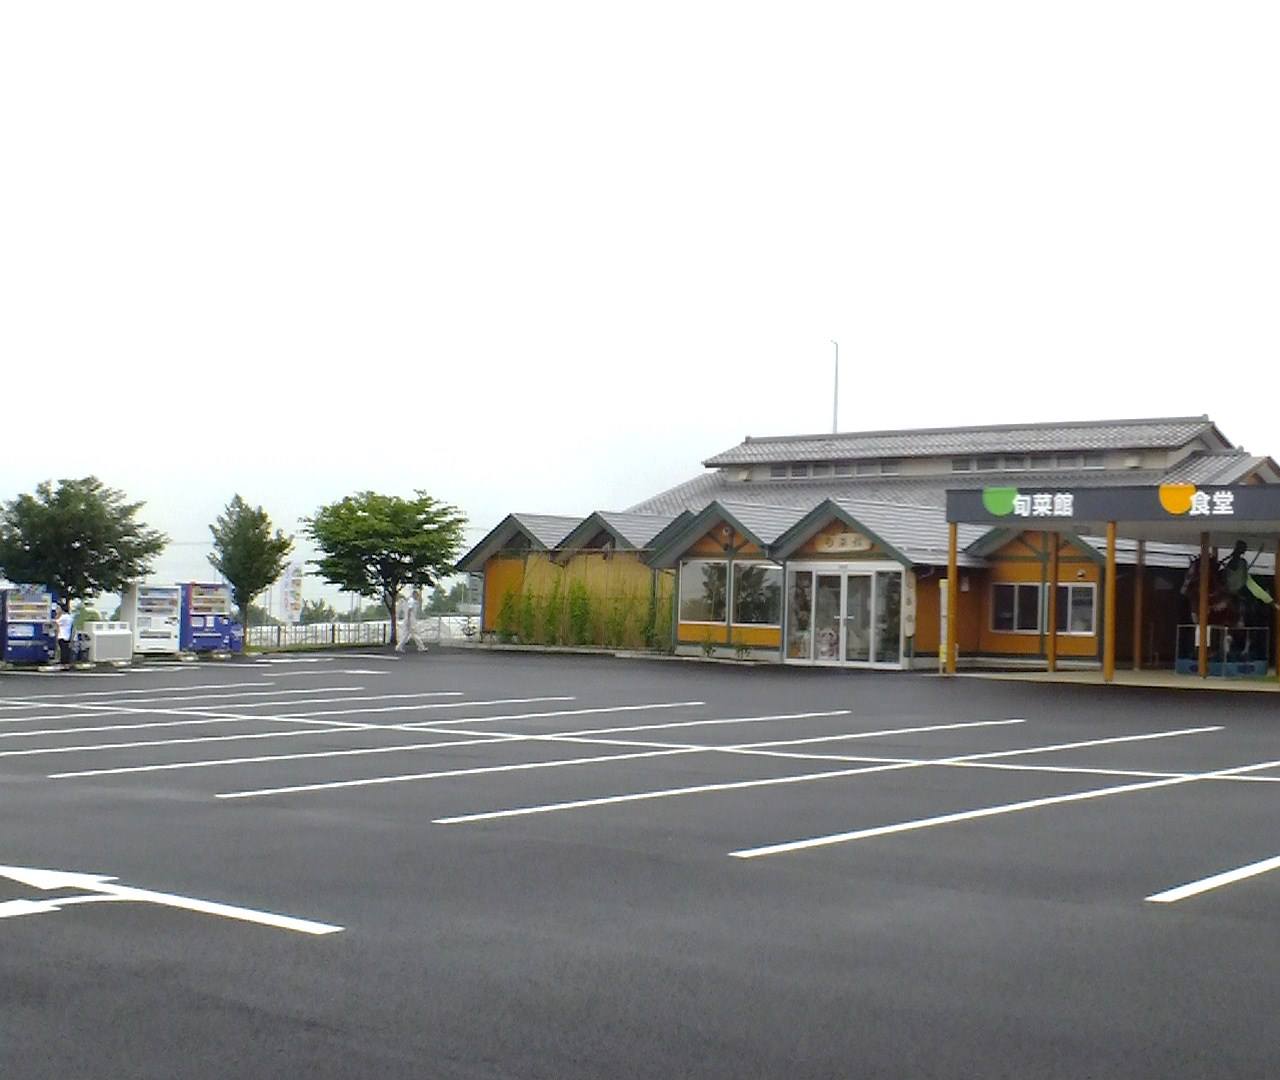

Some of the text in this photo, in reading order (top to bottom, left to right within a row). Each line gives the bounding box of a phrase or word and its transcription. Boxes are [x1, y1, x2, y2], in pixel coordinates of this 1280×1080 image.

[1012, 493, 1075, 518] 旬菜館
[1189, 491, 1235, 516] 食堂
